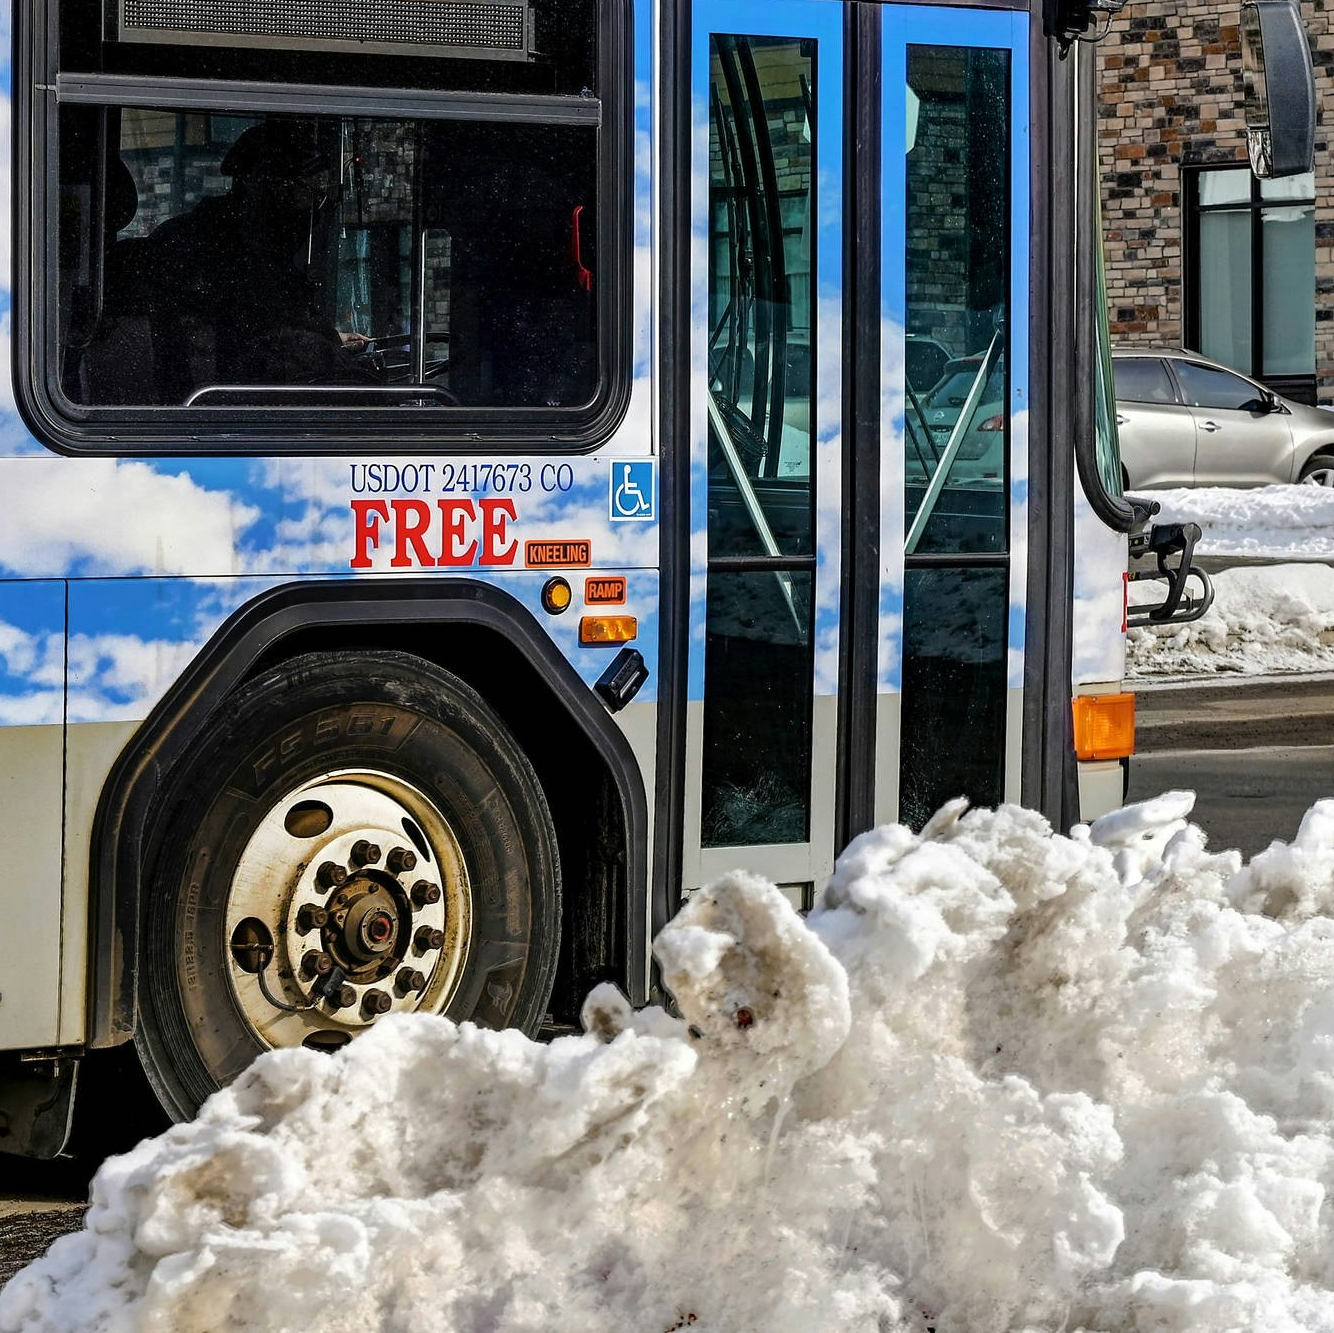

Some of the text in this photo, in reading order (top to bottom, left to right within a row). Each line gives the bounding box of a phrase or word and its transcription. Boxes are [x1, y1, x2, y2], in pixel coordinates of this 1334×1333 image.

[350, 463, 574, 493] USDOT 2417673 CO
[350, 498, 518, 568] FREE
[529, 545, 587, 564] KNEELING
[588, 582, 623, 600] RAMP
